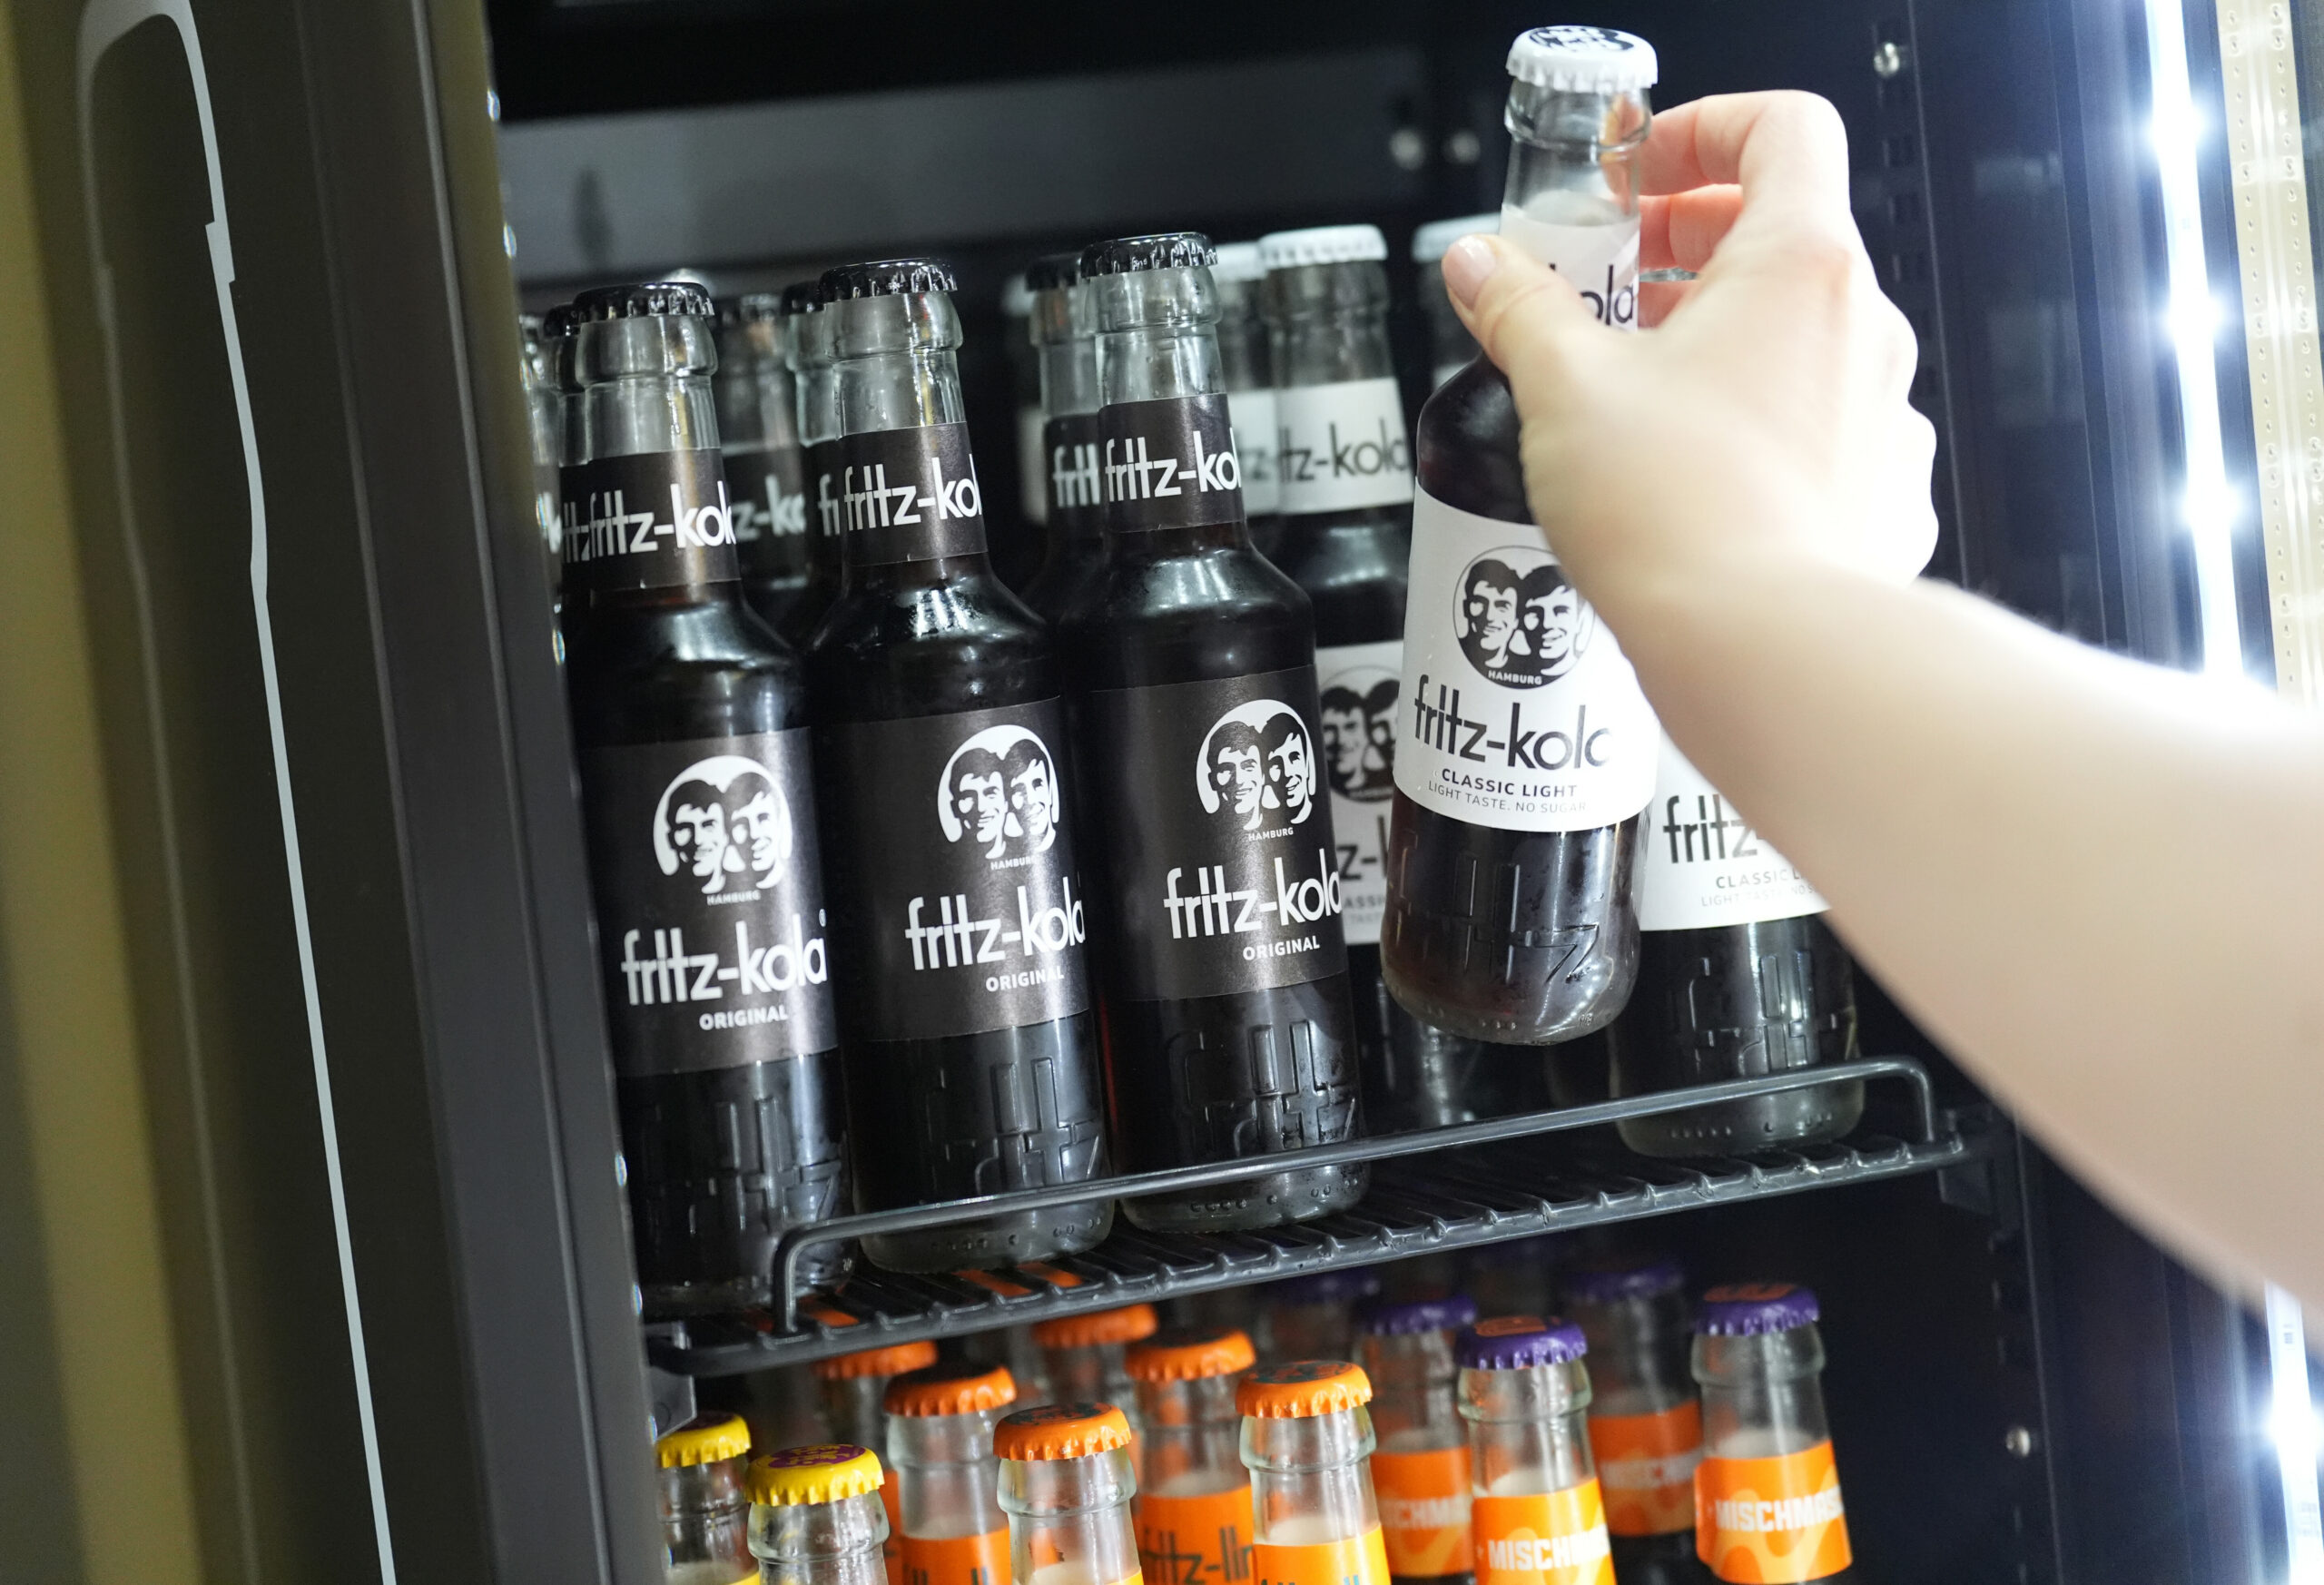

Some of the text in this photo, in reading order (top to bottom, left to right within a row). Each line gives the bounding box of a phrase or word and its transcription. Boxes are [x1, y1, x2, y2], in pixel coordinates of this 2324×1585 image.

[1488, 670, 1542, 685] HAMBURG
[1442, 768, 1578, 797] CLASSIC LIGHT
[1428, 780, 1462, 801] LIGHT
[1465, 792, 1511, 811] TASTE.
[1515, 801, 1535, 812] NO
[1248, 827, 1295, 842] HAMBURG
[706, 889, 761, 906] HAMBURG
[1243, 935, 1320, 960] ORIGINAL
[986, 965, 1065, 992] ORIGINAL
[699, 1004, 789, 1030] ORIGINAL
